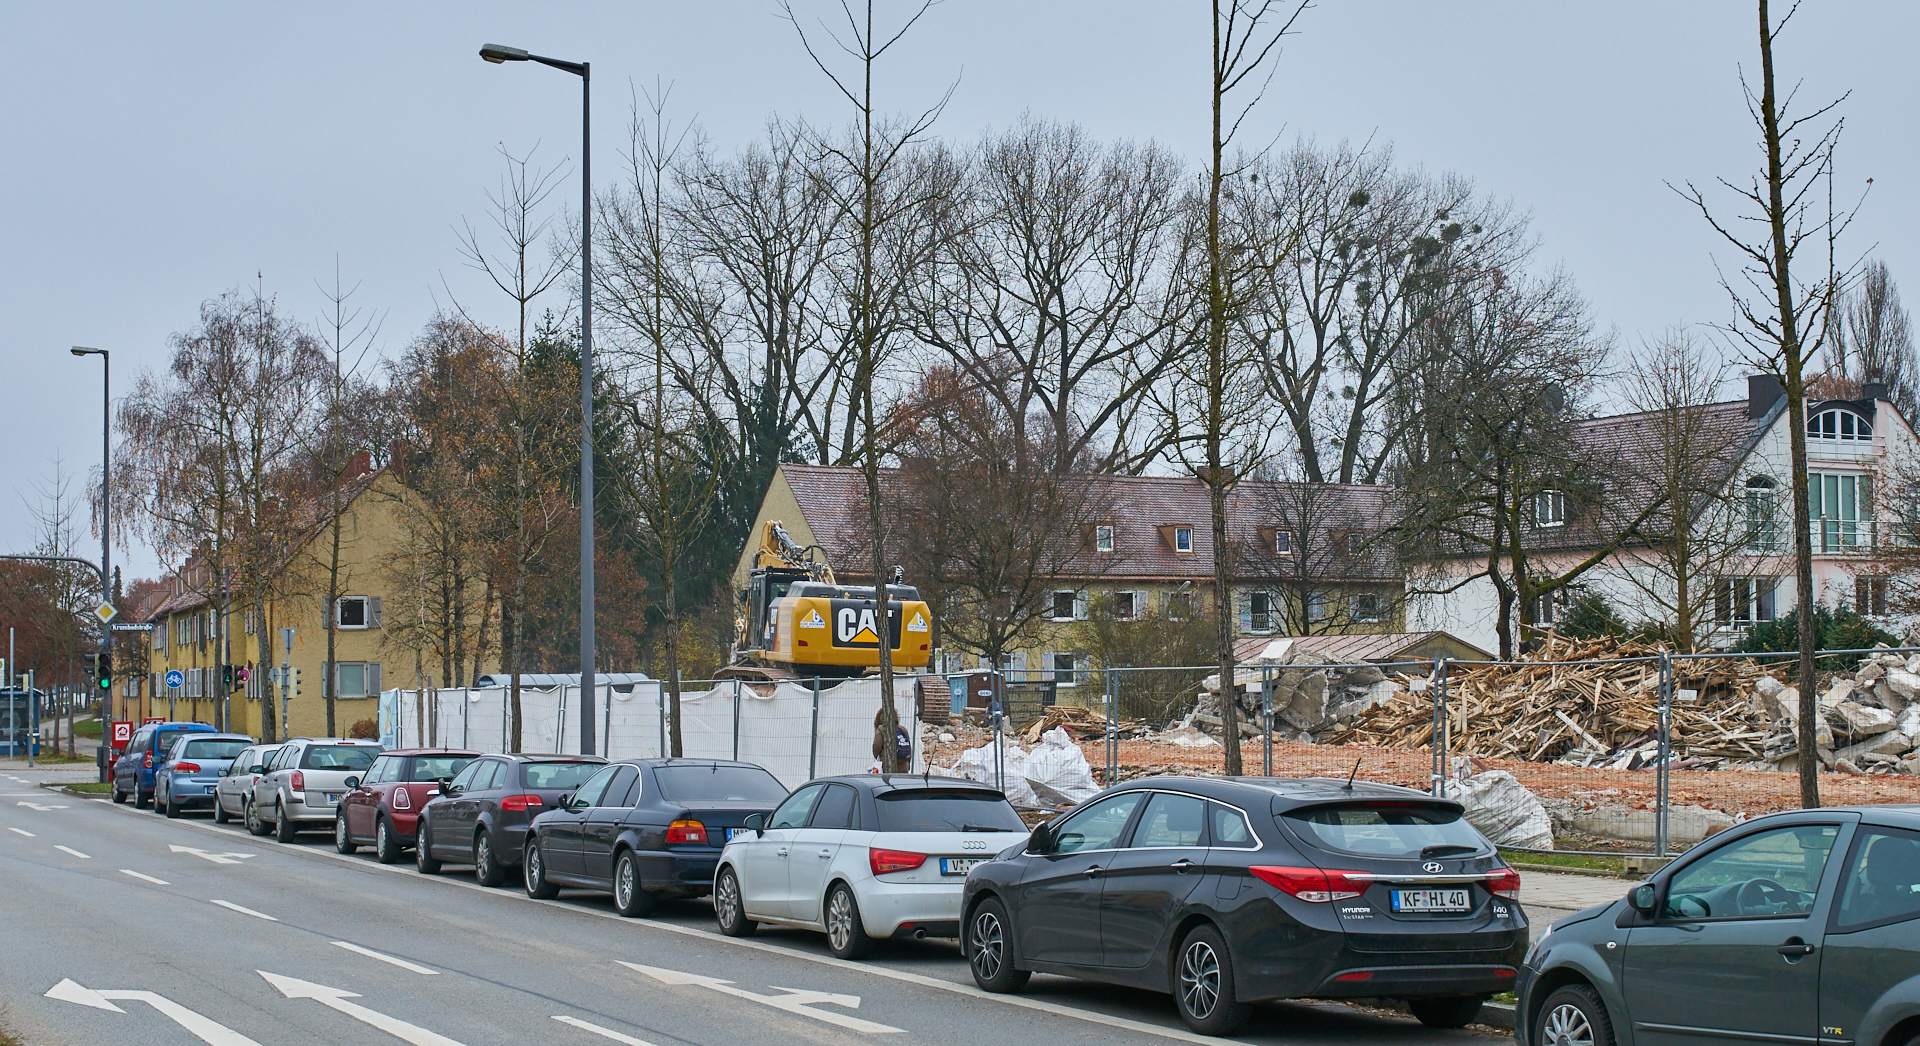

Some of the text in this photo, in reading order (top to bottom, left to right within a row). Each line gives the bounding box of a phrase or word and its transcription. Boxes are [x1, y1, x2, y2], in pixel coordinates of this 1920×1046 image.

[838, 608, 892, 642] CA
[1404, 892, 1464, 907] KF HI 40
[1823, 1026, 1842, 1035] VTR
